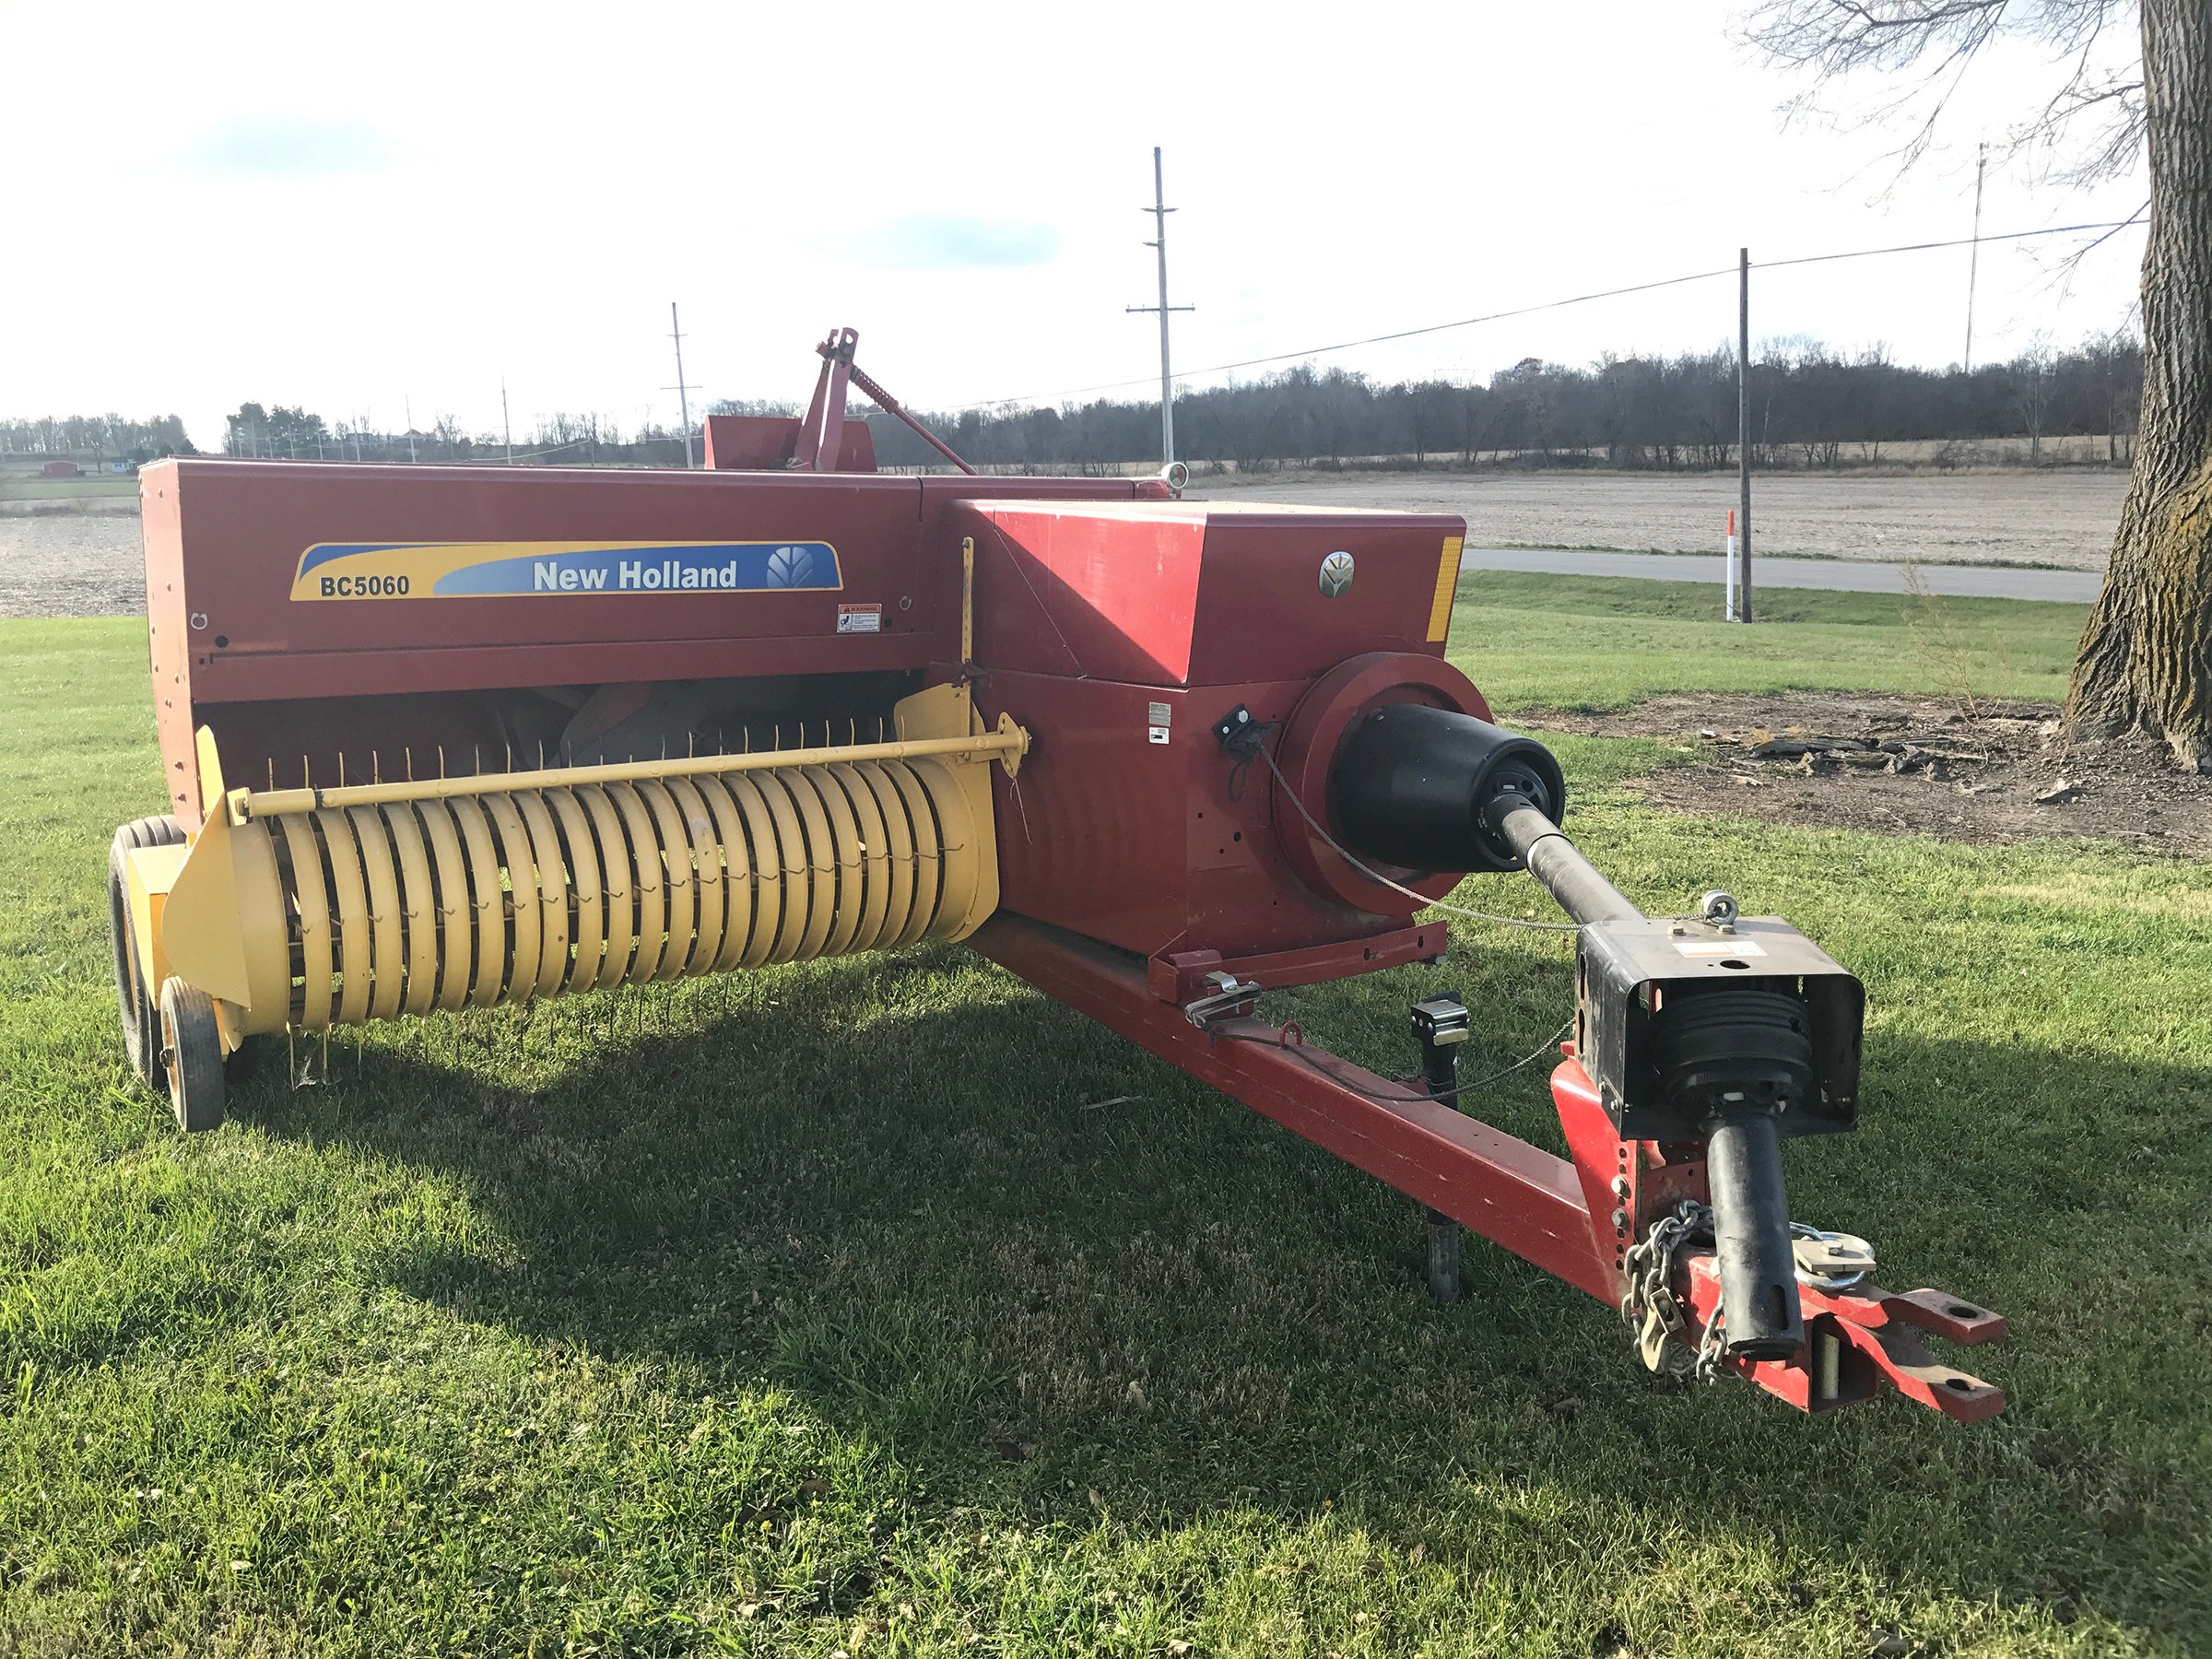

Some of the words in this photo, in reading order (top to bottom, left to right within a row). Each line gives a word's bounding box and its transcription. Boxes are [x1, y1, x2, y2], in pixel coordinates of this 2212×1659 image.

[320, 575, 409, 596] BC5060
[534, 561, 608, 590] New
[618, 560, 736, 589] Holland
